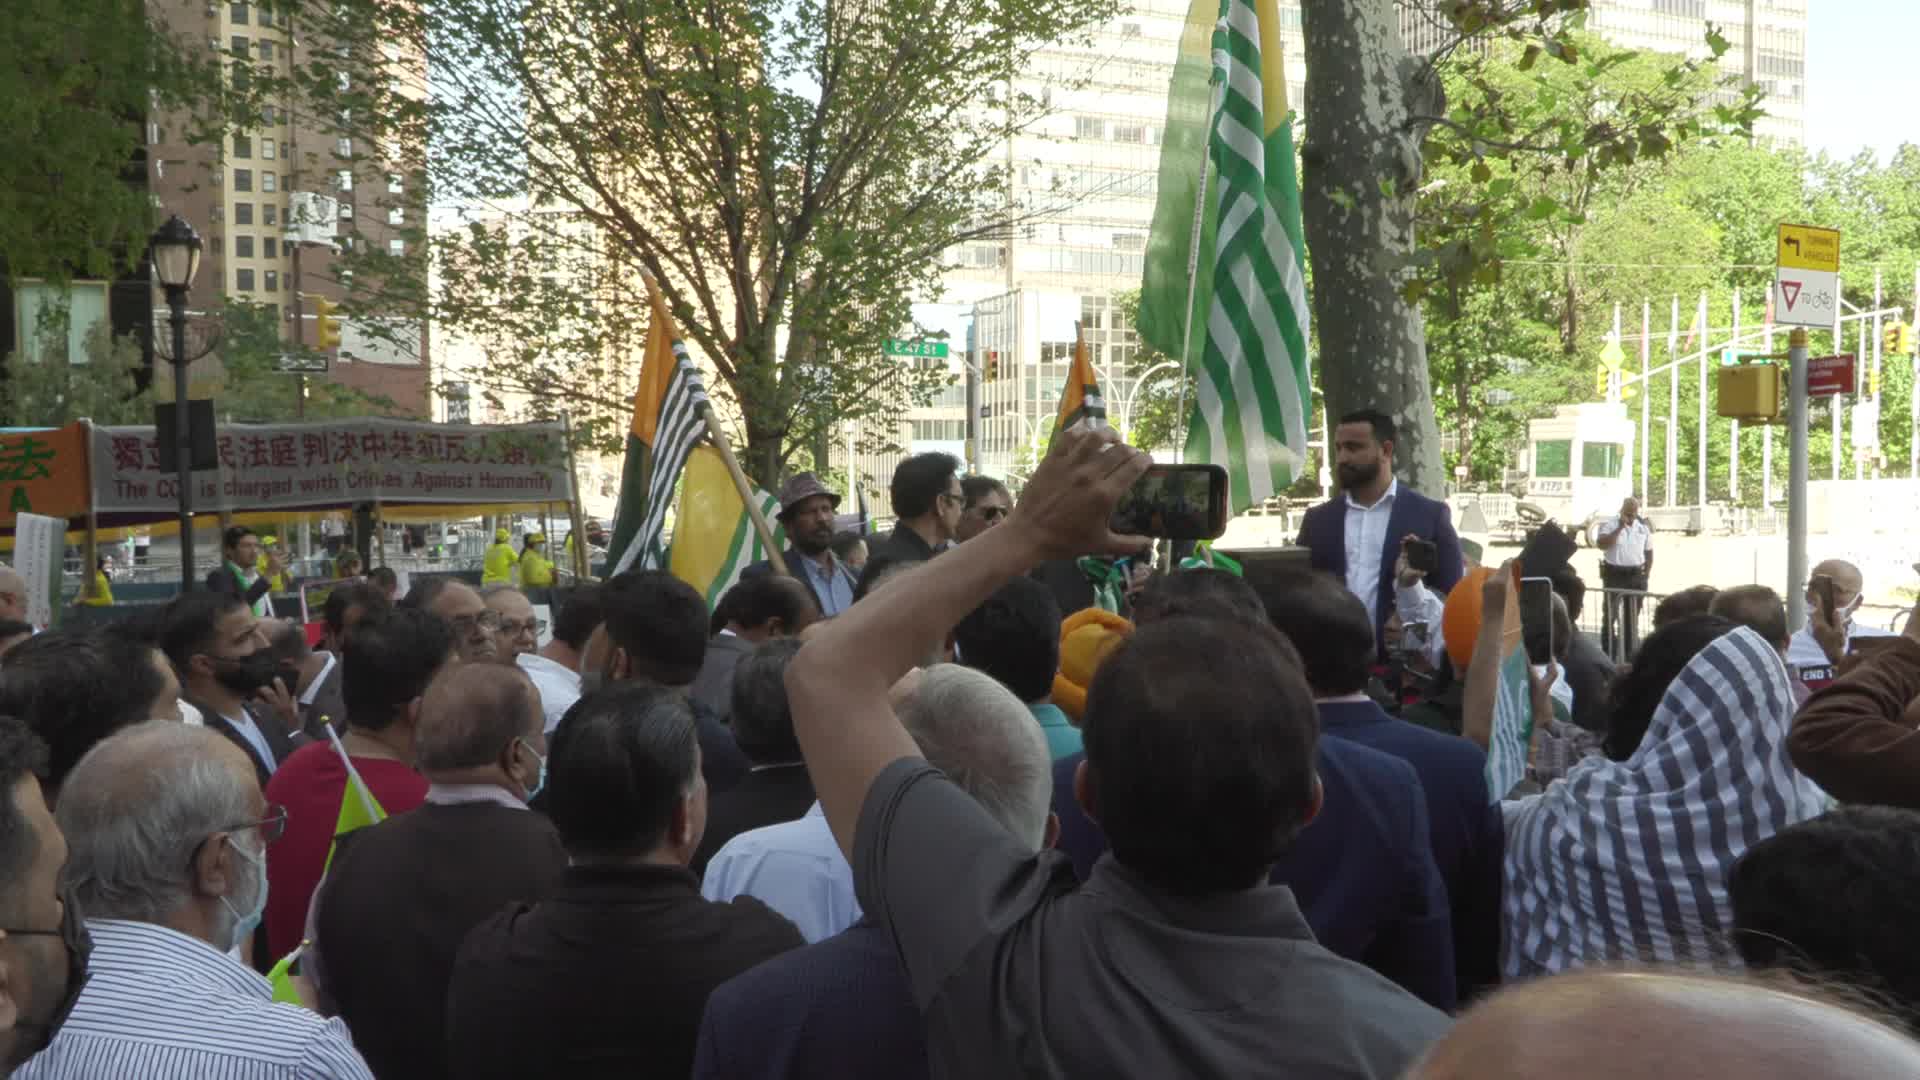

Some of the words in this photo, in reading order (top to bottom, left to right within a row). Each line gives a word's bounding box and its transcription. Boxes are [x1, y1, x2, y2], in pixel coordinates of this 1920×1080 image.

[894, 342, 902, 353] E
[906, 343, 920, 354] 47
[112, 479, 148, 498] The
[201, 478, 217, 497] is
[223, 475, 293, 500] charged
[300, 471, 338, 492] with
[412, 470, 473, 493] Against
[479, 470, 554, 492] Humanity
